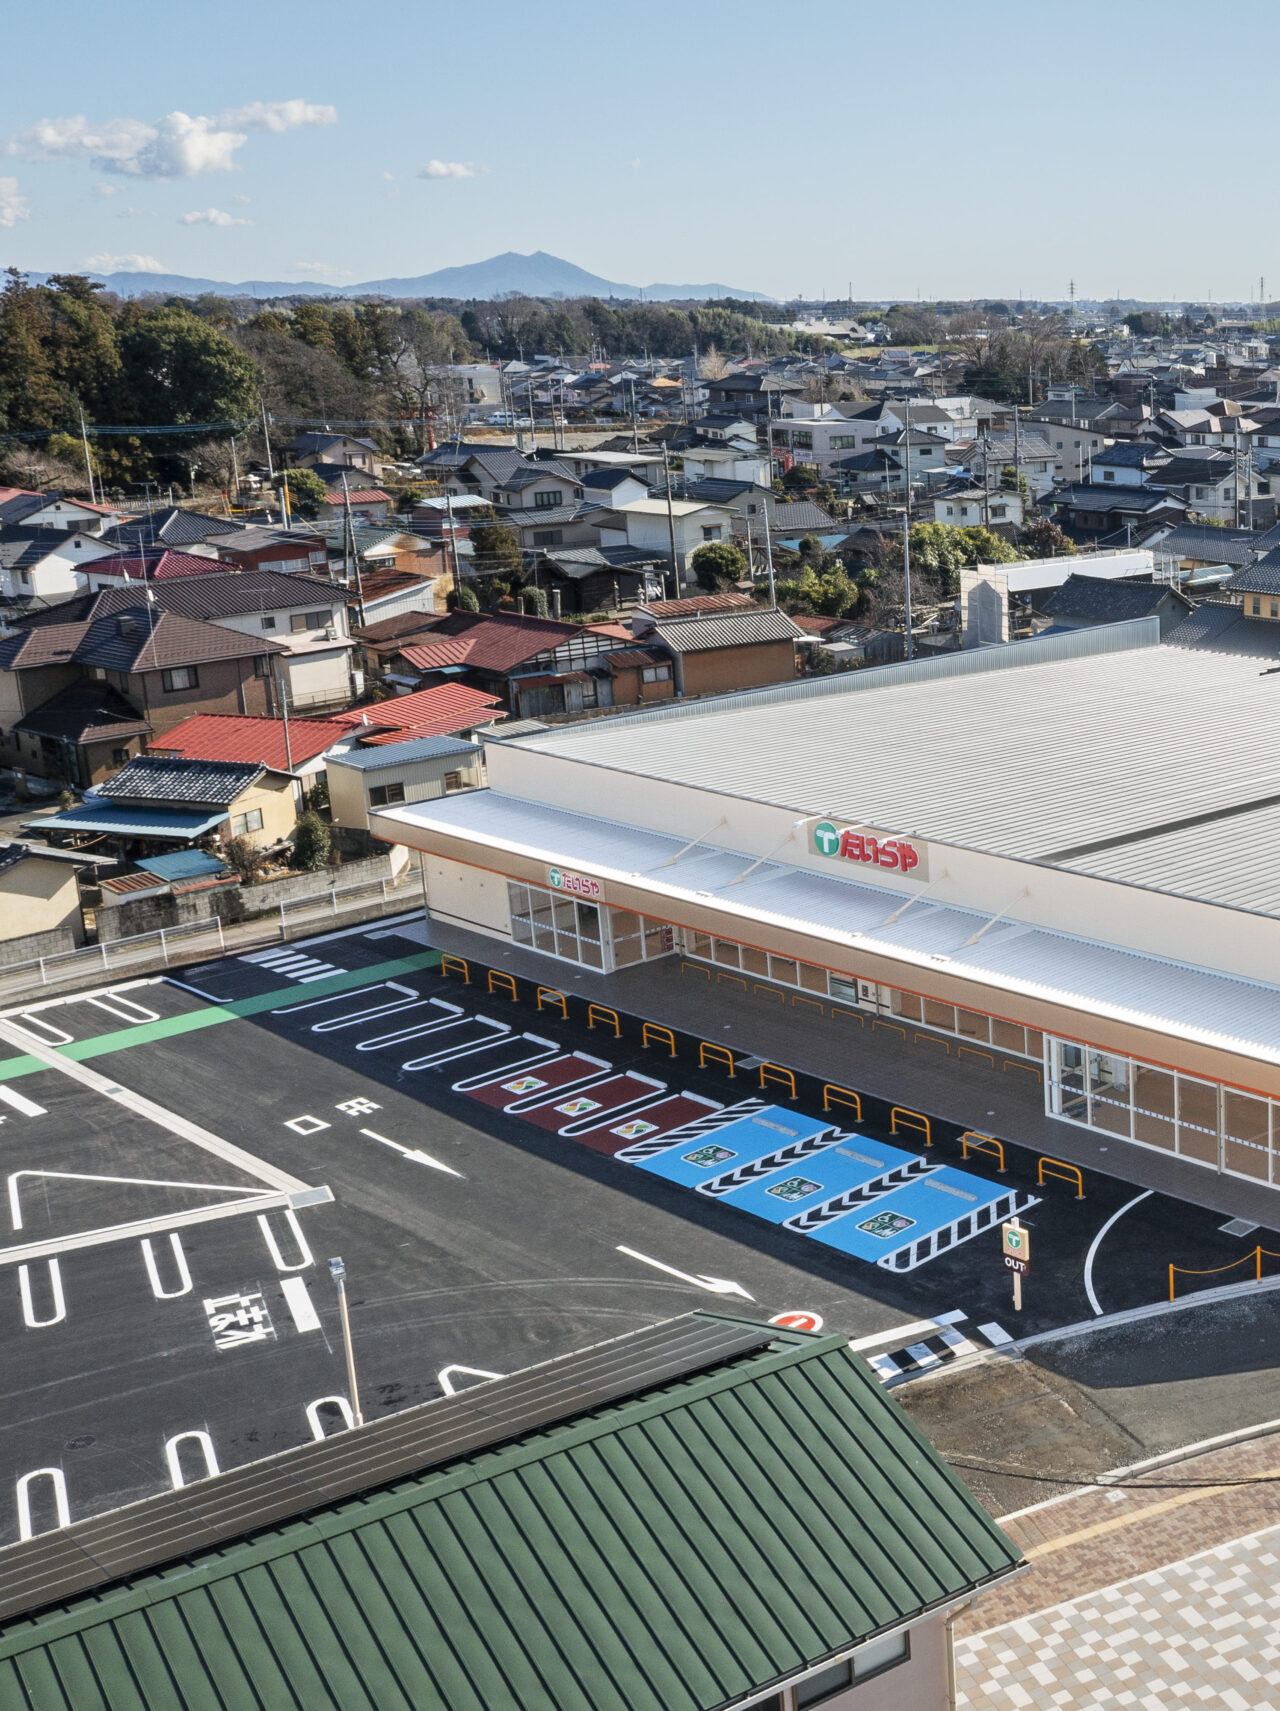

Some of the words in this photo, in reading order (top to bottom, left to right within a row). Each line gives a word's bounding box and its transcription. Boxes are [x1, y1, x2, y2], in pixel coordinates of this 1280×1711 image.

[841, 830, 918, 872] たいらや
[562, 873, 599, 896] たいらや
[1004, 1257, 1025, 1272] OUT
[203, 1293, 274, 1350] 止まれ
